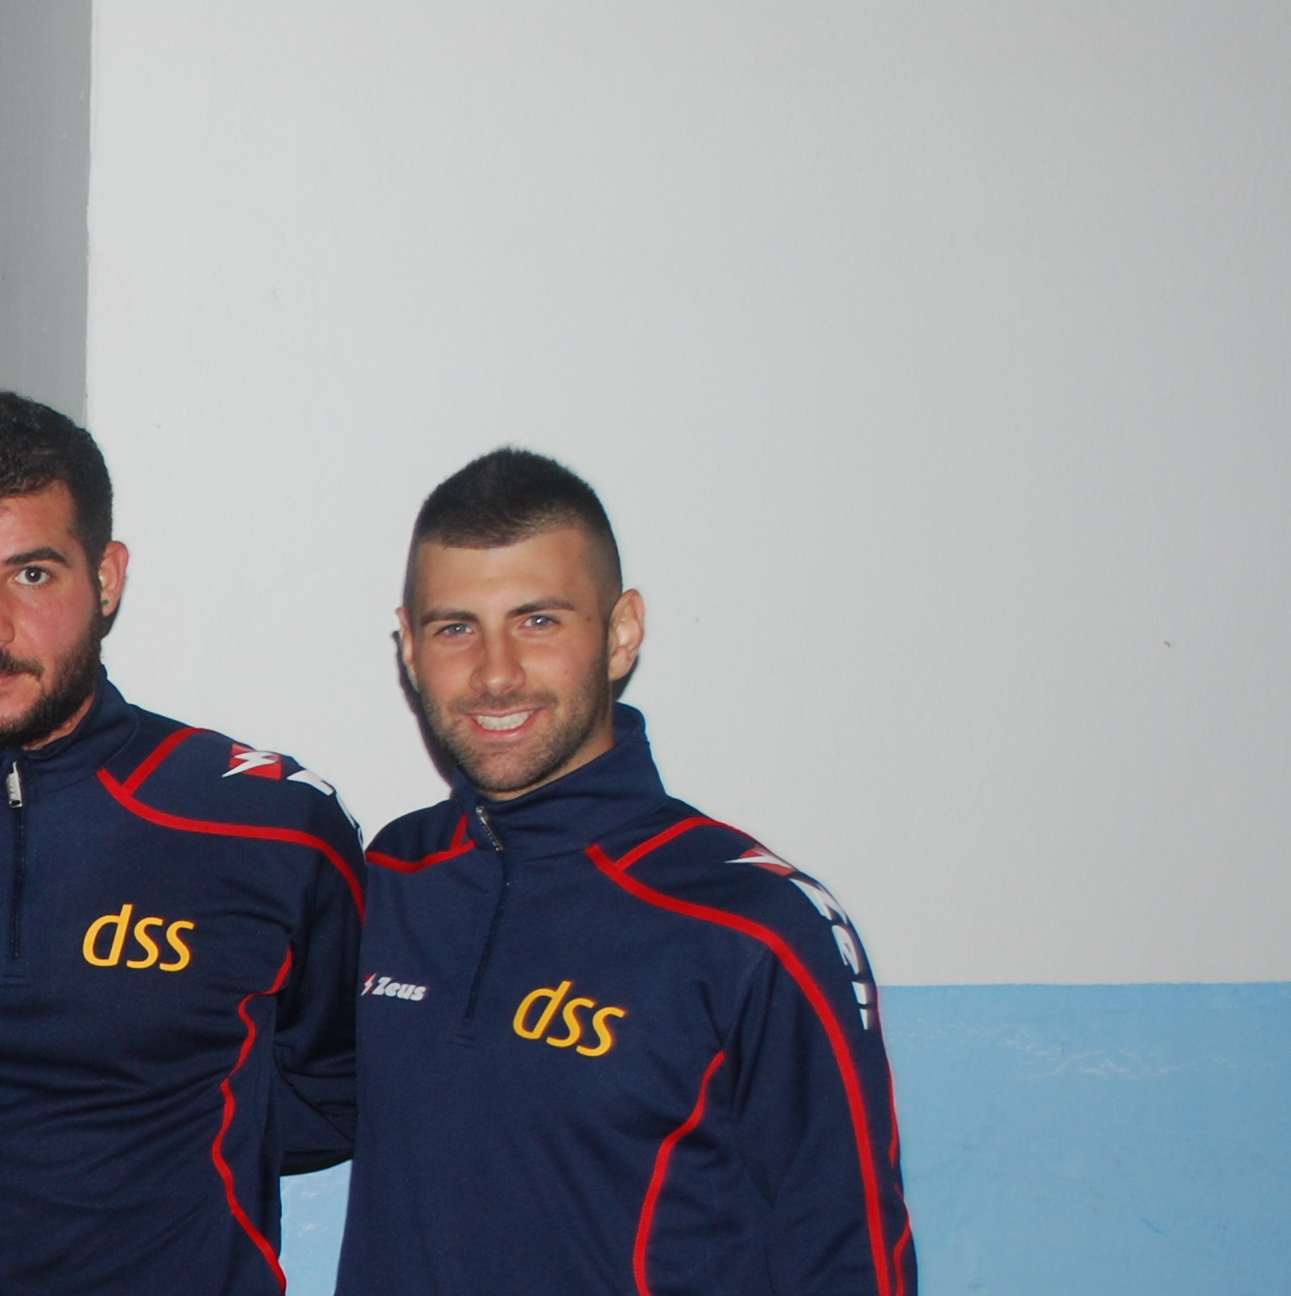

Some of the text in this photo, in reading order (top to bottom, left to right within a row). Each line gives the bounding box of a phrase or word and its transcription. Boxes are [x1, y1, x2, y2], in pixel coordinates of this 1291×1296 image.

[82, 903, 196, 972] dss
[372, 976, 427, 1001] Zeus
[512, 981, 626, 1057] dss
